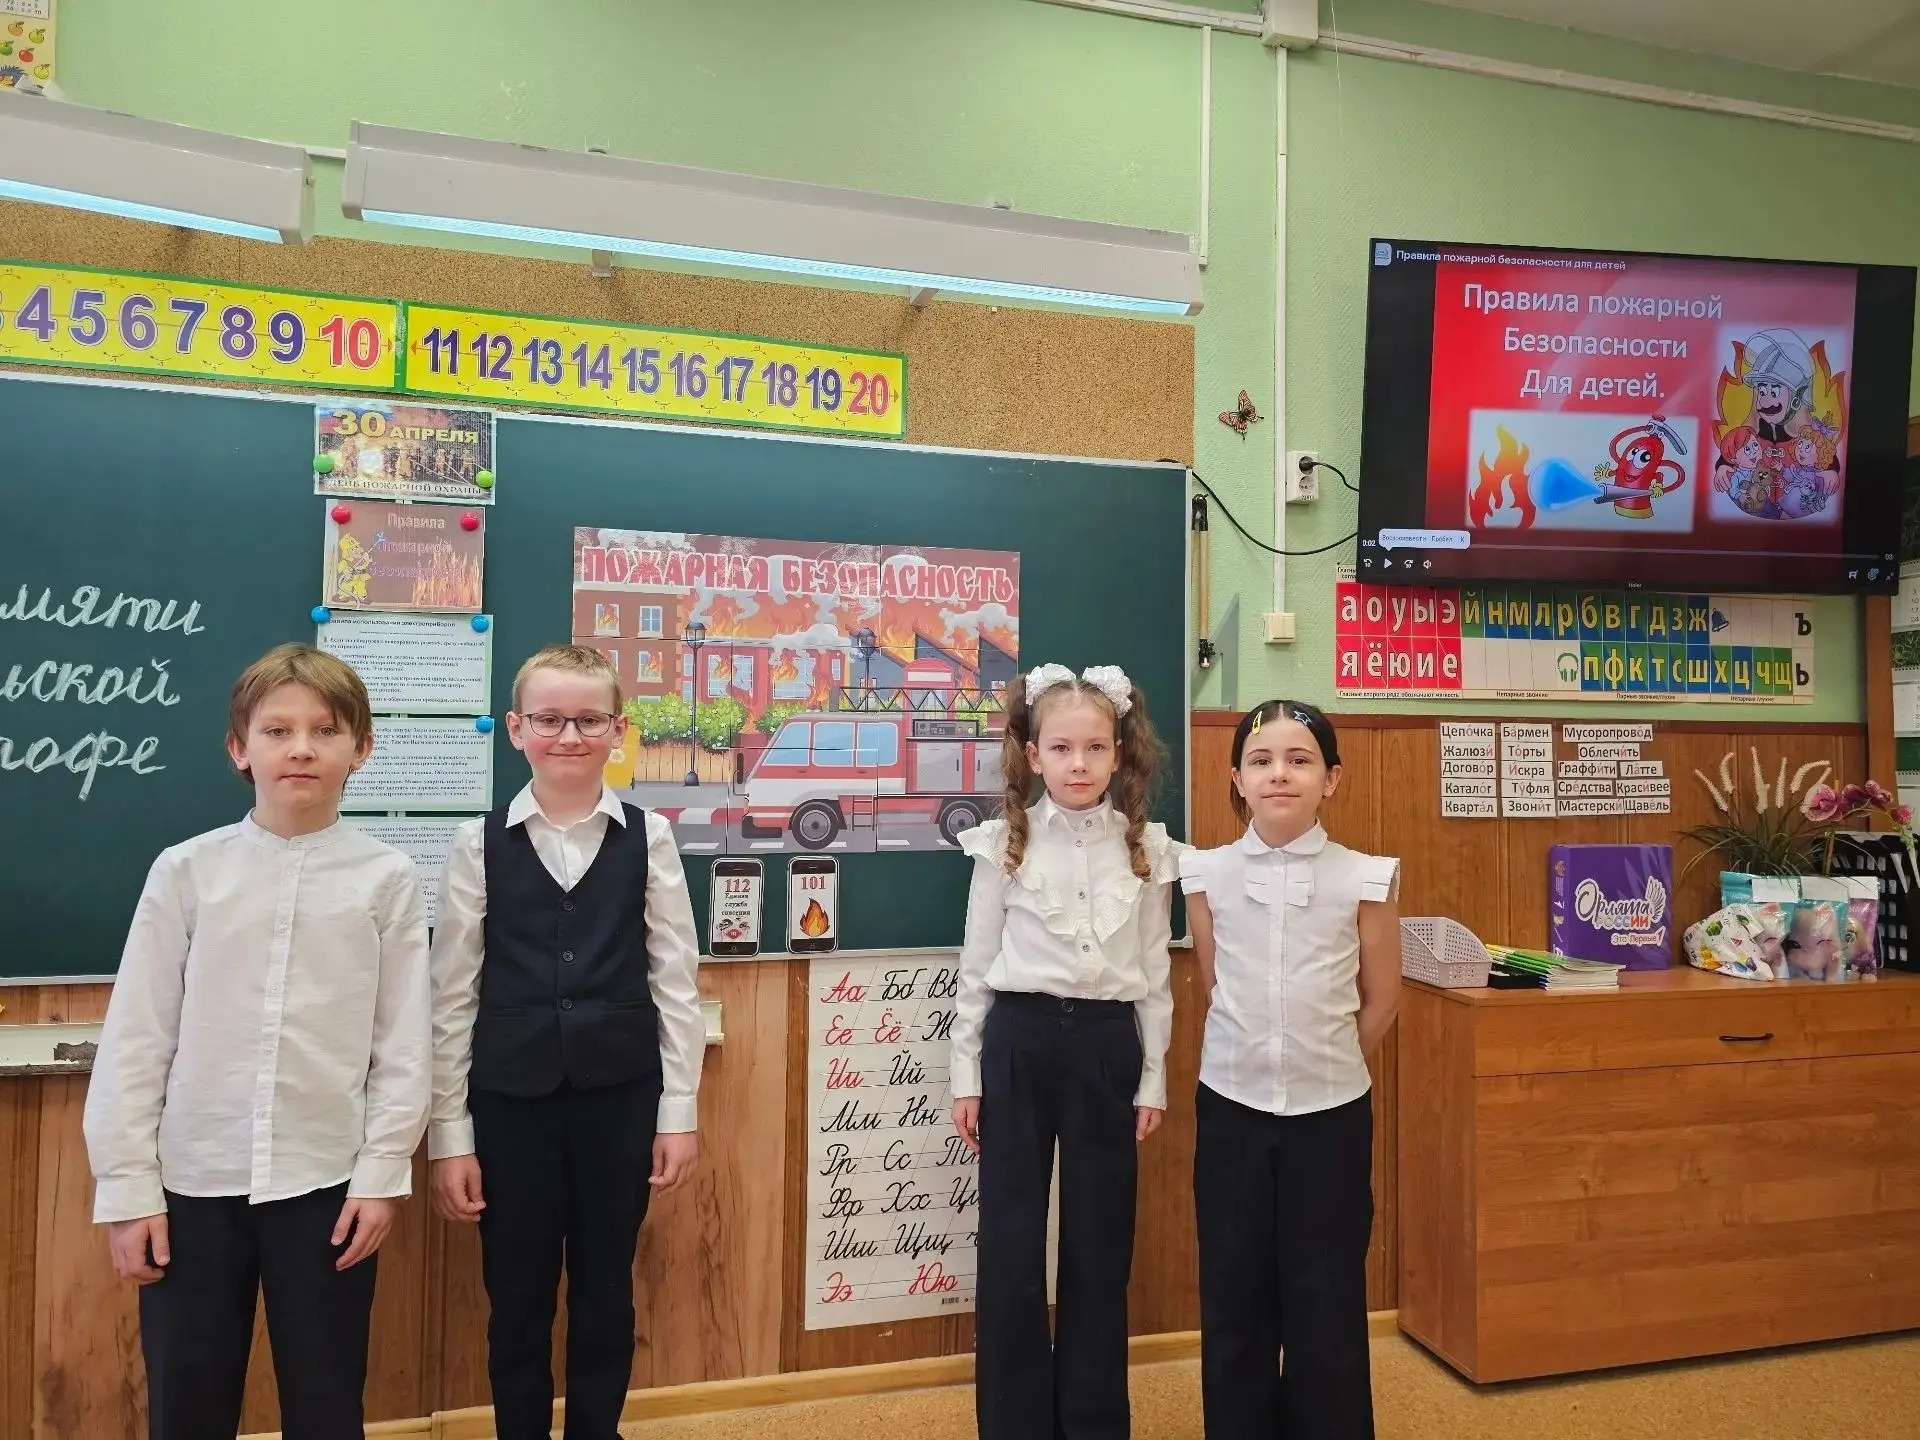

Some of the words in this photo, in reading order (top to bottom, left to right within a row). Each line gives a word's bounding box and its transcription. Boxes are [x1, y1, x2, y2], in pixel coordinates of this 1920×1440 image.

[1396, 250, 1441, 262] Правила
[1443, 253, 1496, 265] пожарной
[1497, 253, 1572, 268] безопасности
[1573, 259, 1593, 270] для
[1594, 260, 1626, 271] детей
[1464, 283, 1579, 315] Правила
[1588, 292, 1723, 322] пожарной
[14, 285, 58, 342] 4
[69, 288, 108, 347] 5
[119, 294, 158, 351] 6
[169, 298, 208, 354] 7
[219, 305, 257, 360] 8
[268, 310, 305, 364] 9
[319, 315, 381, 370] 10
[1504, 326, 1688, 359] Безопасности
[422, 327, 459, 375] 11
[471, 332, 513, 380] 12
[522, 337, 563, 385] 13
[571, 341, 613, 390] 14
[621, 347, 660, 395] 15
[668, 351, 708, 399] 16
[715, 355, 754, 402] 17
[762, 361, 798, 408] 18
[805, 366, 842, 411] 19
[848, 370, 889, 416] 20
[1519, 369, 1573, 398] Для
[1579, 372, 1666, 400] детей.
[332, 409, 386, 437] 30
[389, 425, 479, 444] АПРЕЛЯ
[363, 480, 431, 492] ПОЖАРНОЙ
[434, 484, 481, 494] ОХРАНЫ
[388, 512, 446, 531] Правила
[582, 546, 770, 592] ПОЖАРНАЯ
[780, 559, 1017, 603] БЕЗОПАСНОСТЬ
[328, 618, 351, 626] равила
[1341, 595, 1358, 622] а
[1366, 596, 1383, 622] о
[1392, 597, 1406, 633] у
[1413, 598, 1435, 624] ы
[1441, 599, 1456, 624] э
[1464, 590, 1480, 625] й
[1487, 601, 1503, 625] н
[1509, 602, 1529, 626] м
[1535, 602, 1551, 627] л
[1557, 601, 1574, 636] р
[1581, 596, 1598, 629] б
[1605, 604, 1621, 629] в
[1630, 605, 1642, 629] г
[1649, 606, 1667, 636] д
[1671, 607, 1683, 632] з
[1688, 607, 1707, 632] ж
[0, 656, 180, 706] ьской
[1341, 651, 1358, 677] я
[1367, 642, 1383, 678] ё
[1389, 651, 1411, 678] ю
[1417, 652, 1433, 678] и
[1442, 652, 1459, 679] е
[1583, 656, 1599, 681] п
[1604, 648, 1624, 690] ф
[1629, 657, 1644, 682] к
[1651, 658, 1665, 683] т
[1672, 659, 1682, 683] с
[1688, 659, 1708, 684] ш
[1714, 659, 1728, 684] х
[1735, 660, 1750, 690] ц
[1756, 661, 1770, 685] ч
[1773, 662, 1792, 691] щ
[1339, 690, 1362, 698] Гласные
[1363, 691, 1386, 699] второго
[1401, 691, 1435, 699] обозначают
[1496, 690, 1525, 699] Непарные
[724, 878, 751, 893] 112
[801, 875, 826, 890] 101
[1577, 880, 1651, 923] Орлята
[821, 971, 866, 1003] Аа
[881, 968, 928, 1000] Бб
[928, 968, 959, 998] Вв
[825, 1014, 852, 1045] Ее
[874, 1008, 902, 1042] Ёё
[922, 1010, 958, 1041] Ж
[827, 1057, 865, 1089] Ии
[889, 1050, 926, 1085] Йй
[821, 1100, 882, 1133] Мм
[899, 1094, 939, 1127] Нн
[820, 1143, 857, 1188] Рр
[883, 1139, 912, 1171] Сс
[936, 1135, 979, 1166] Т
[822, 1187, 864, 1229] Фф
[881, 1180, 931, 1214] Хх
[823, 1228, 878, 1261] Шш
[894, 1221, 954, 1261] Щщ
[821, 1271, 853, 1303] Ээ
[909, 1262, 959, 1295] Юю
